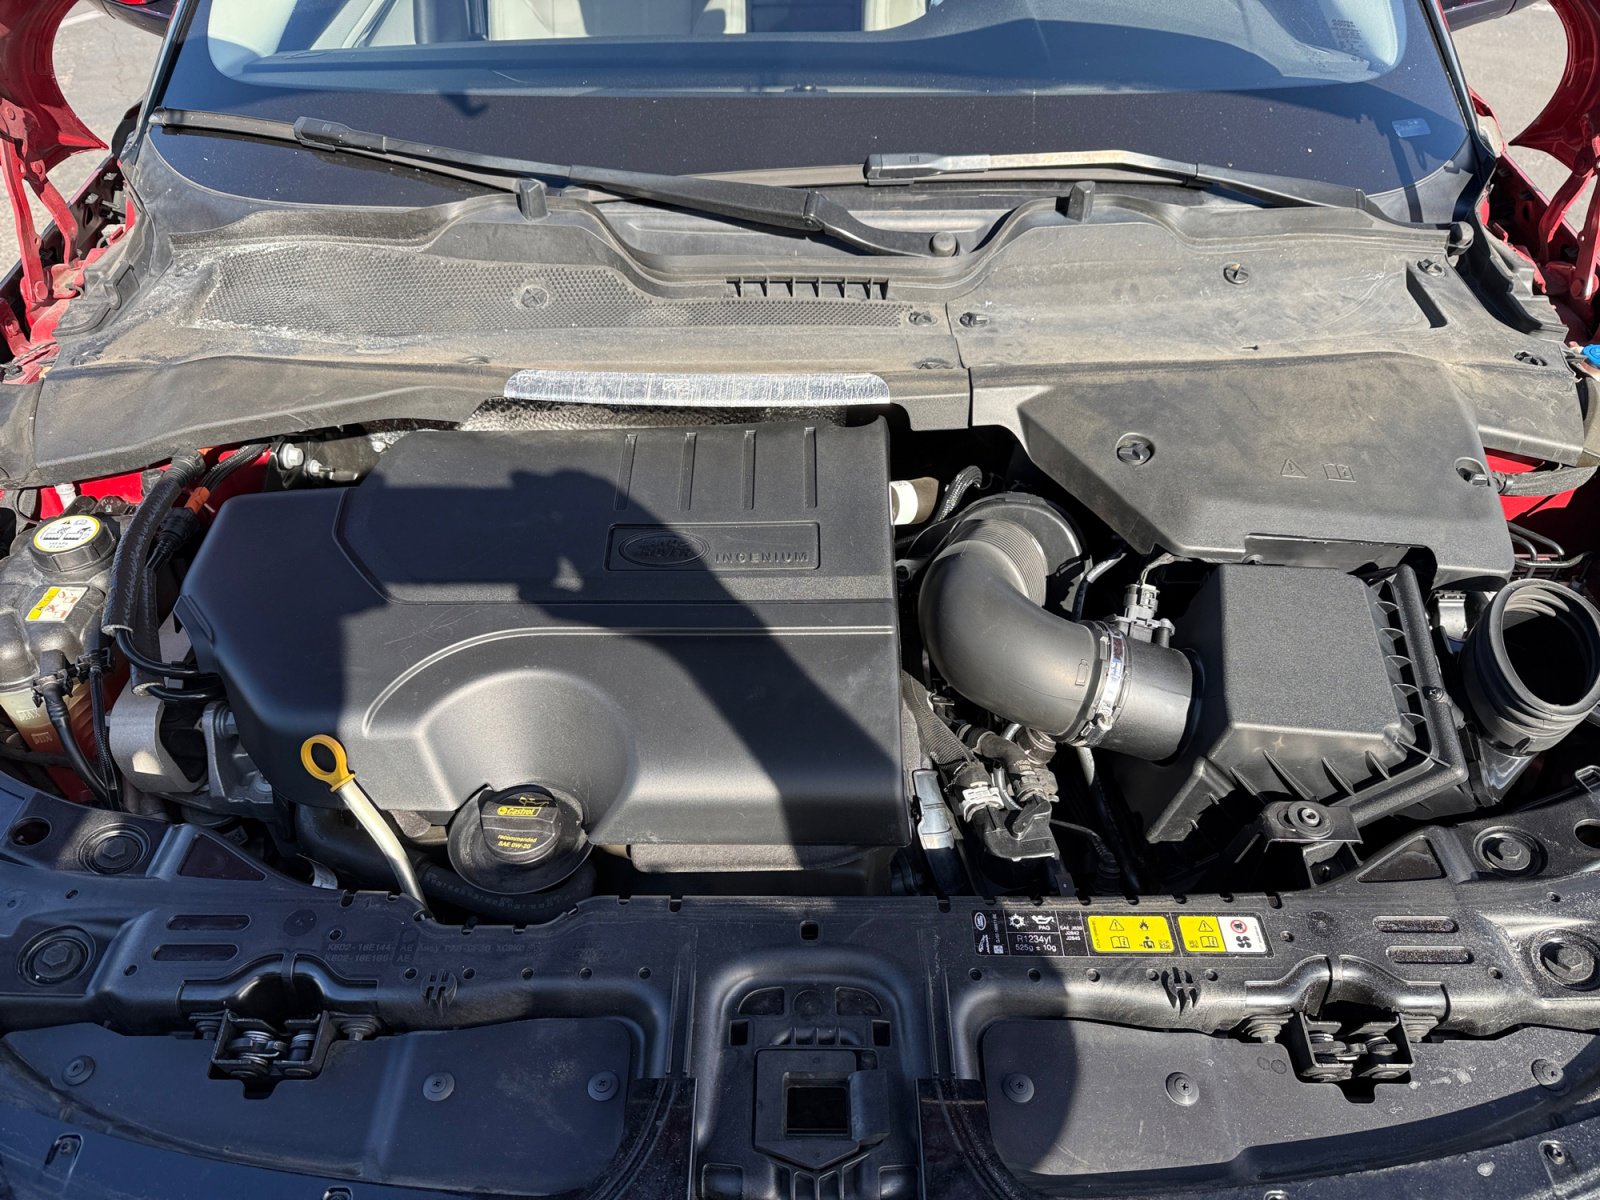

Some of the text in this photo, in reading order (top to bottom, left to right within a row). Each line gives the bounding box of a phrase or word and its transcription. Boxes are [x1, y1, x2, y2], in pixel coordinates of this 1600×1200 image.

[714, 551, 809, 564] INGENIUM
[507, 806, 535, 816] Castrol
[497, 834, 538, 843] recommended
[498, 840, 511, 848] SAE
[1016, 935, 1052, 945] R1234yf
[1015, 944, 1034, 952] 525g
[1043, 944, 1057, 953] 10g
